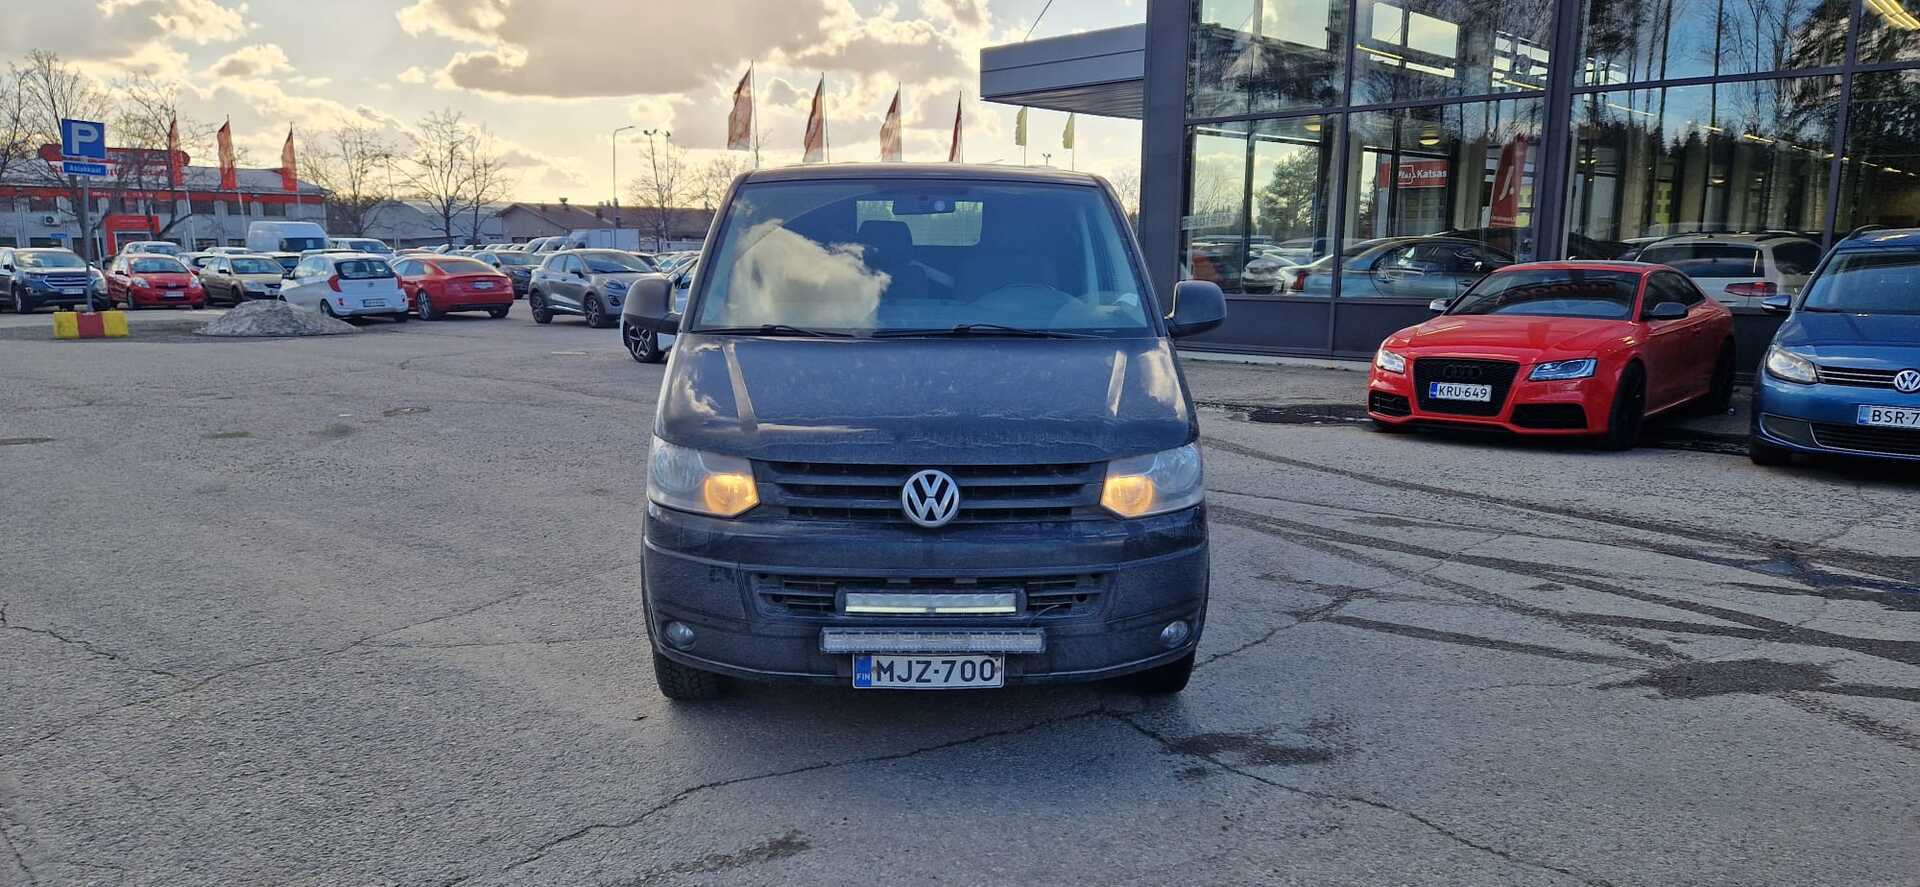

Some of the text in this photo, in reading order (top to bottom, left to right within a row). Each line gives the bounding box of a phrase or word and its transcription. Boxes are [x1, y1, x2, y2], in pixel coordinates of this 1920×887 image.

[71, 122, 99, 154] P
[1438, 385, 1488, 398] KRU-649
[856, 659, 996, 683] FIN MJZ-700
